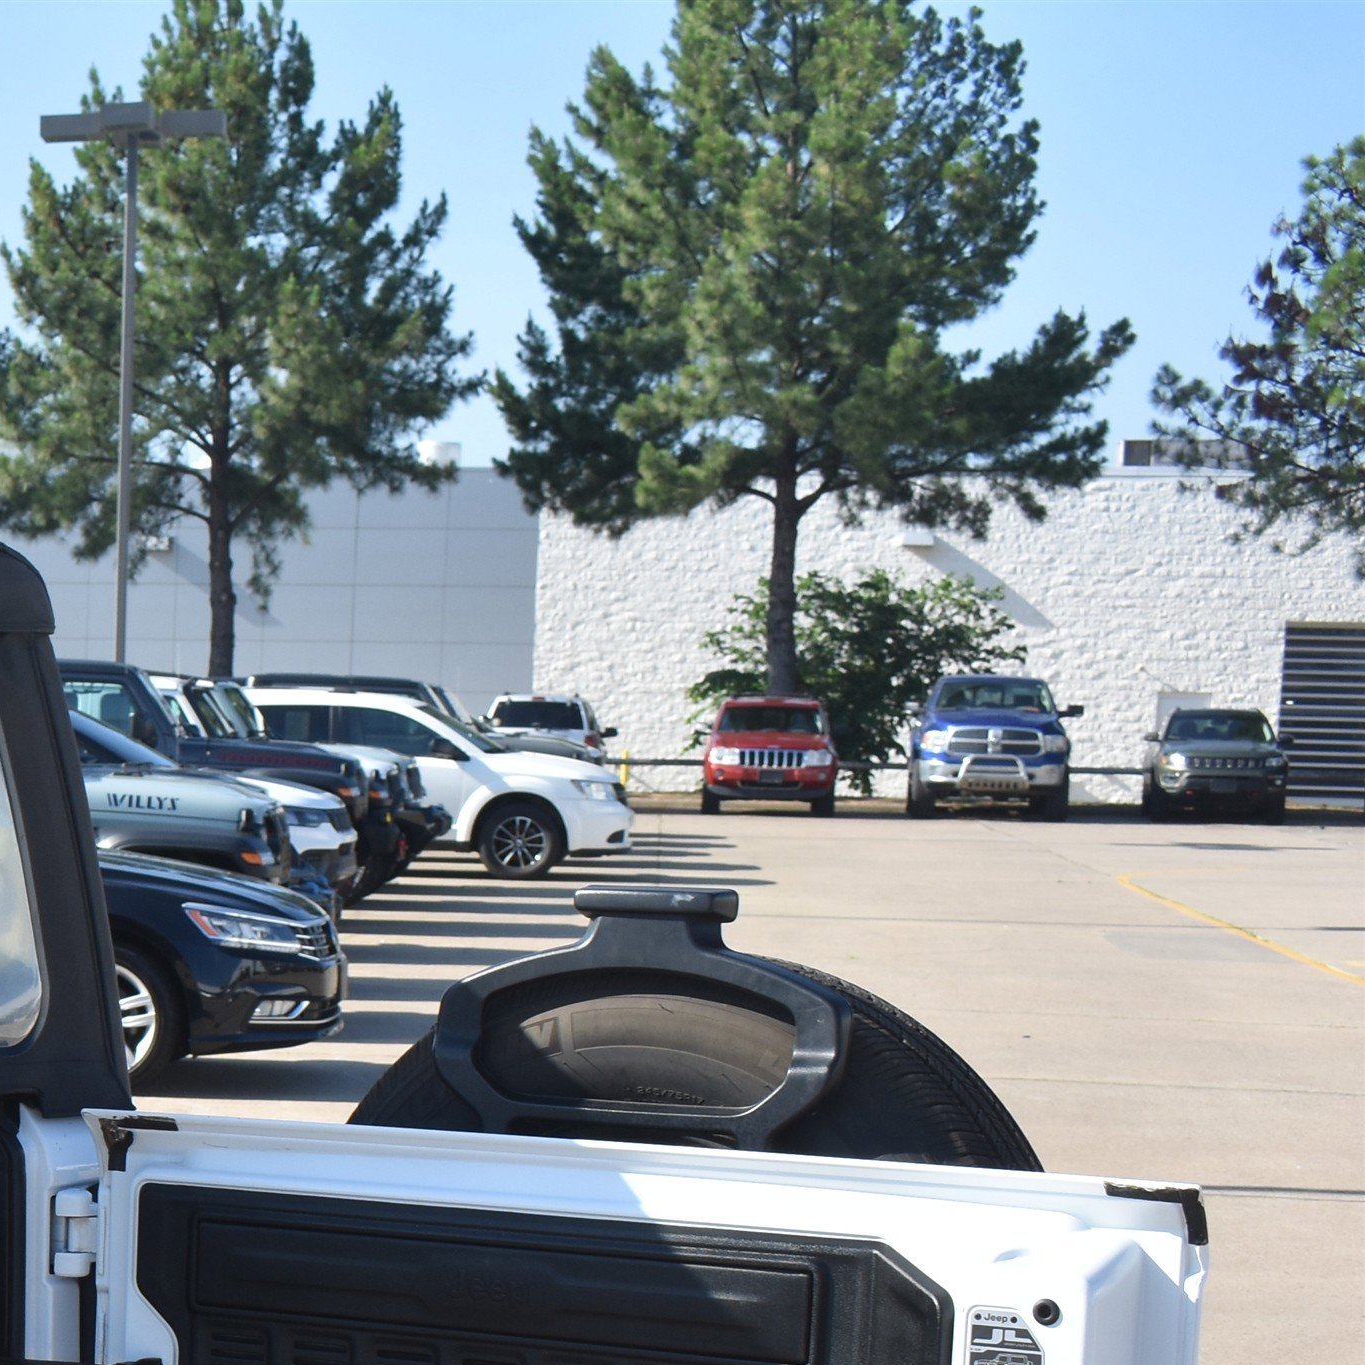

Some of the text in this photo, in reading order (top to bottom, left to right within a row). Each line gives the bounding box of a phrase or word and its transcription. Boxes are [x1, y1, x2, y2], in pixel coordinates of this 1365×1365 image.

[107, 793, 180, 811] WILLYS
[984, 1313, 1008, 1323] Jeep
[972, 1328, 1033, 1345] JL
